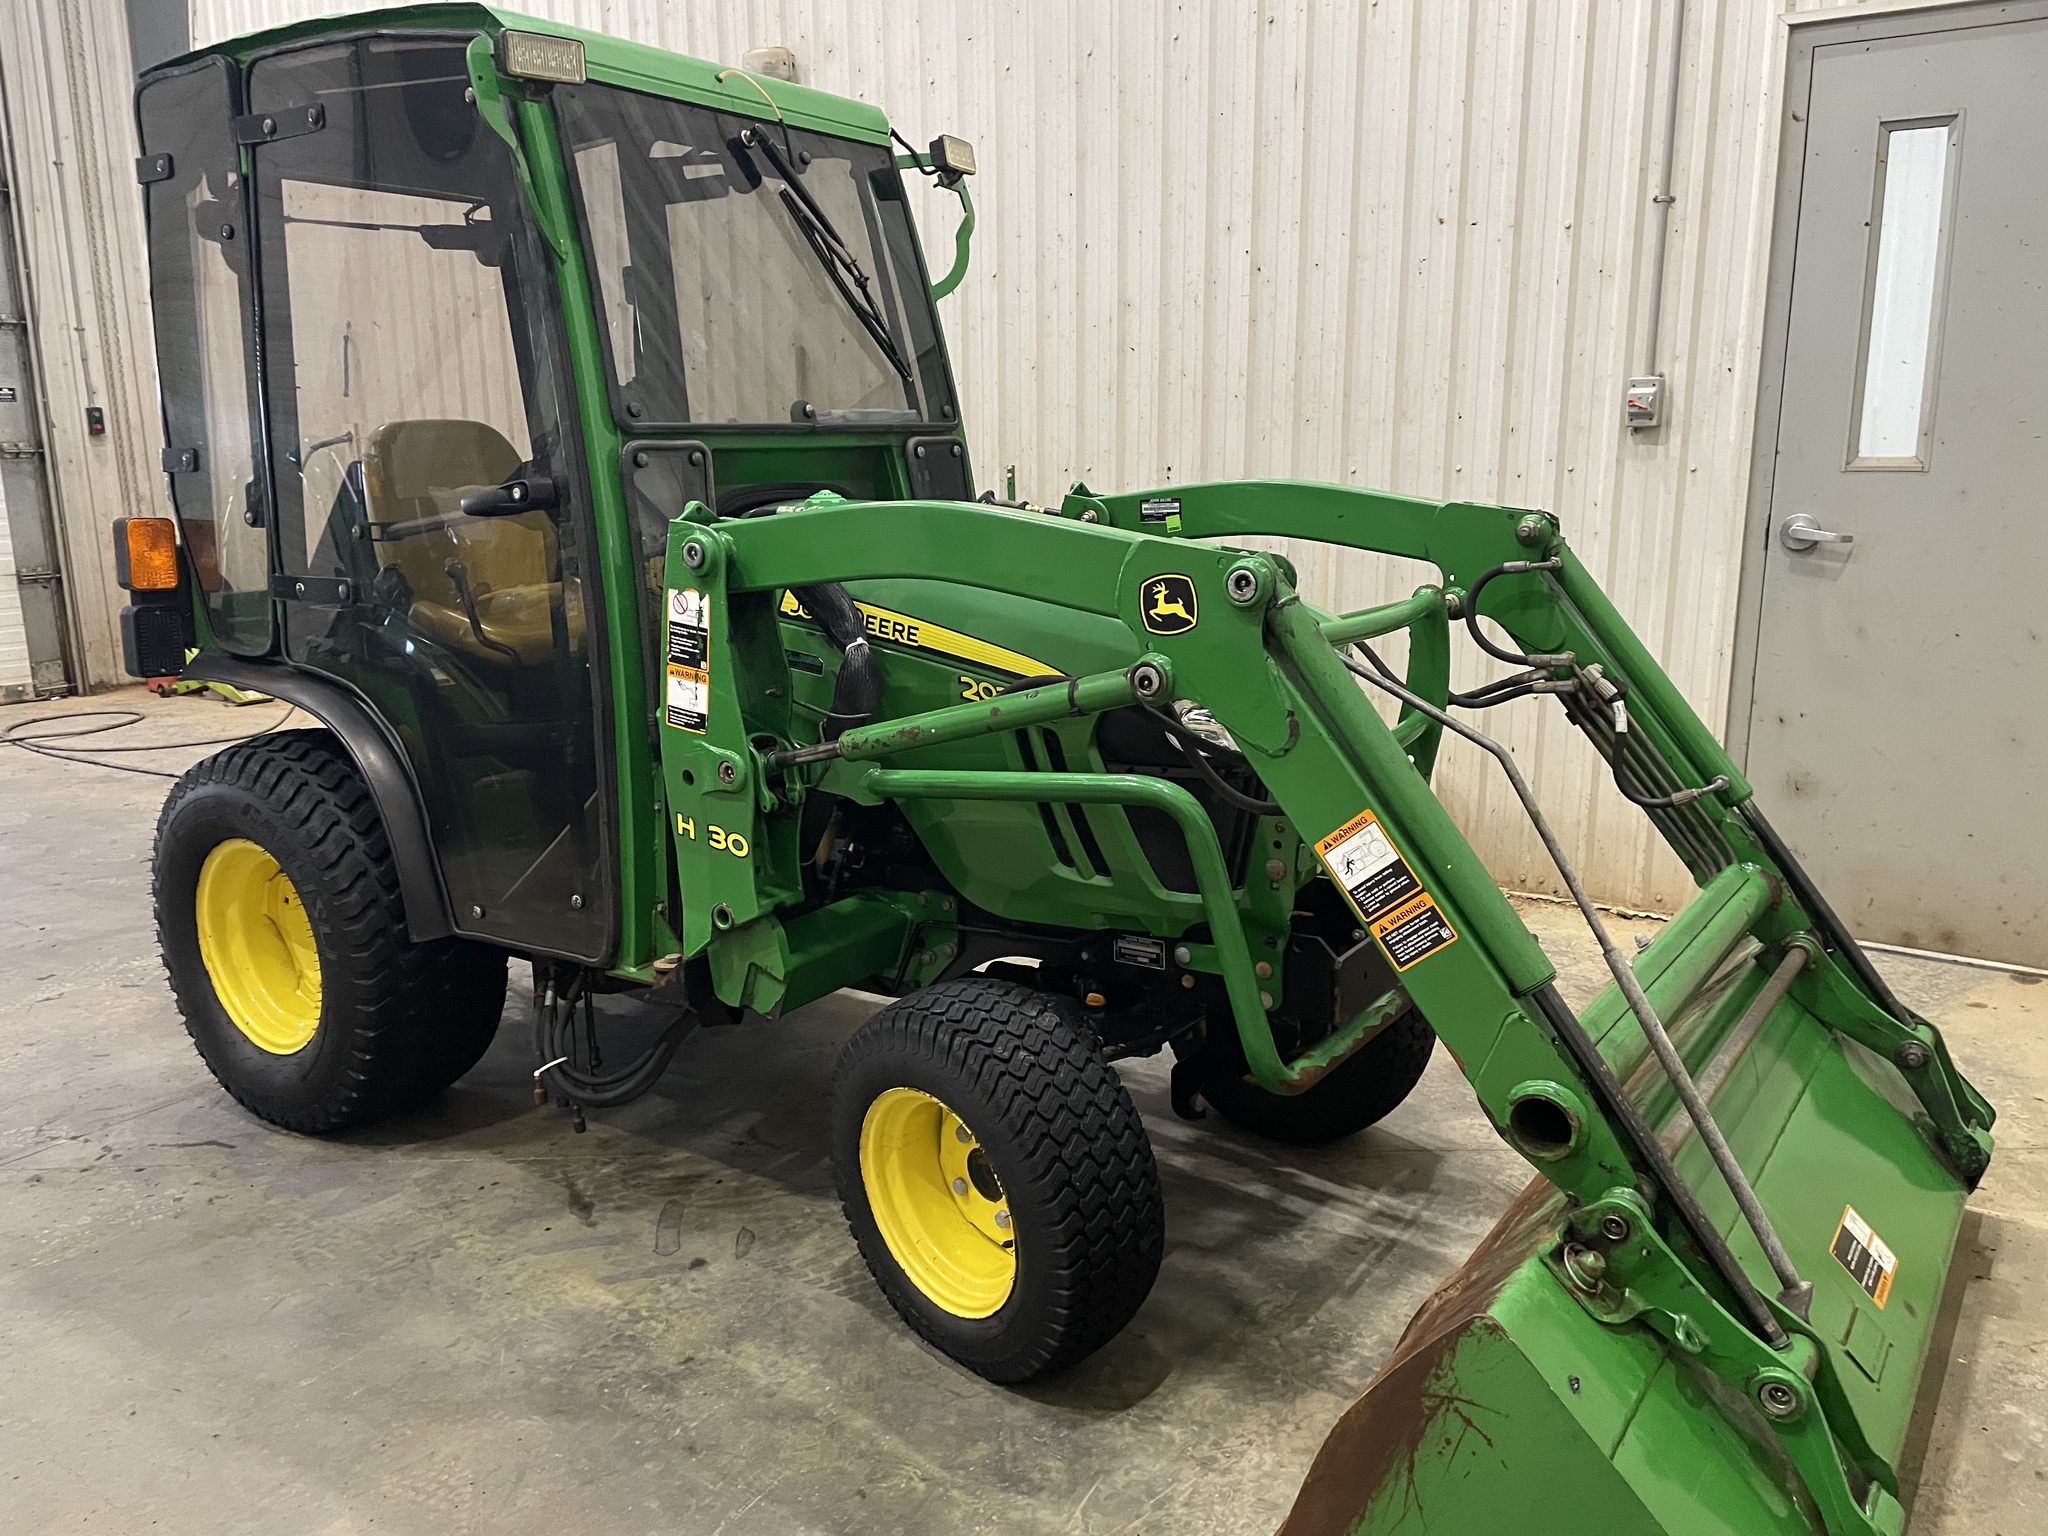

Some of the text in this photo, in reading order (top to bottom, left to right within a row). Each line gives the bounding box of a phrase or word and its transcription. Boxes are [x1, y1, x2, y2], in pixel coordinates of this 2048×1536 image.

[959, 675, 1006, 701] 20
[676, 812, 750, 858] H 30
[1330, 815, 1368, 845] WARNING
[1387, 899, 1427, 927] WARNING
